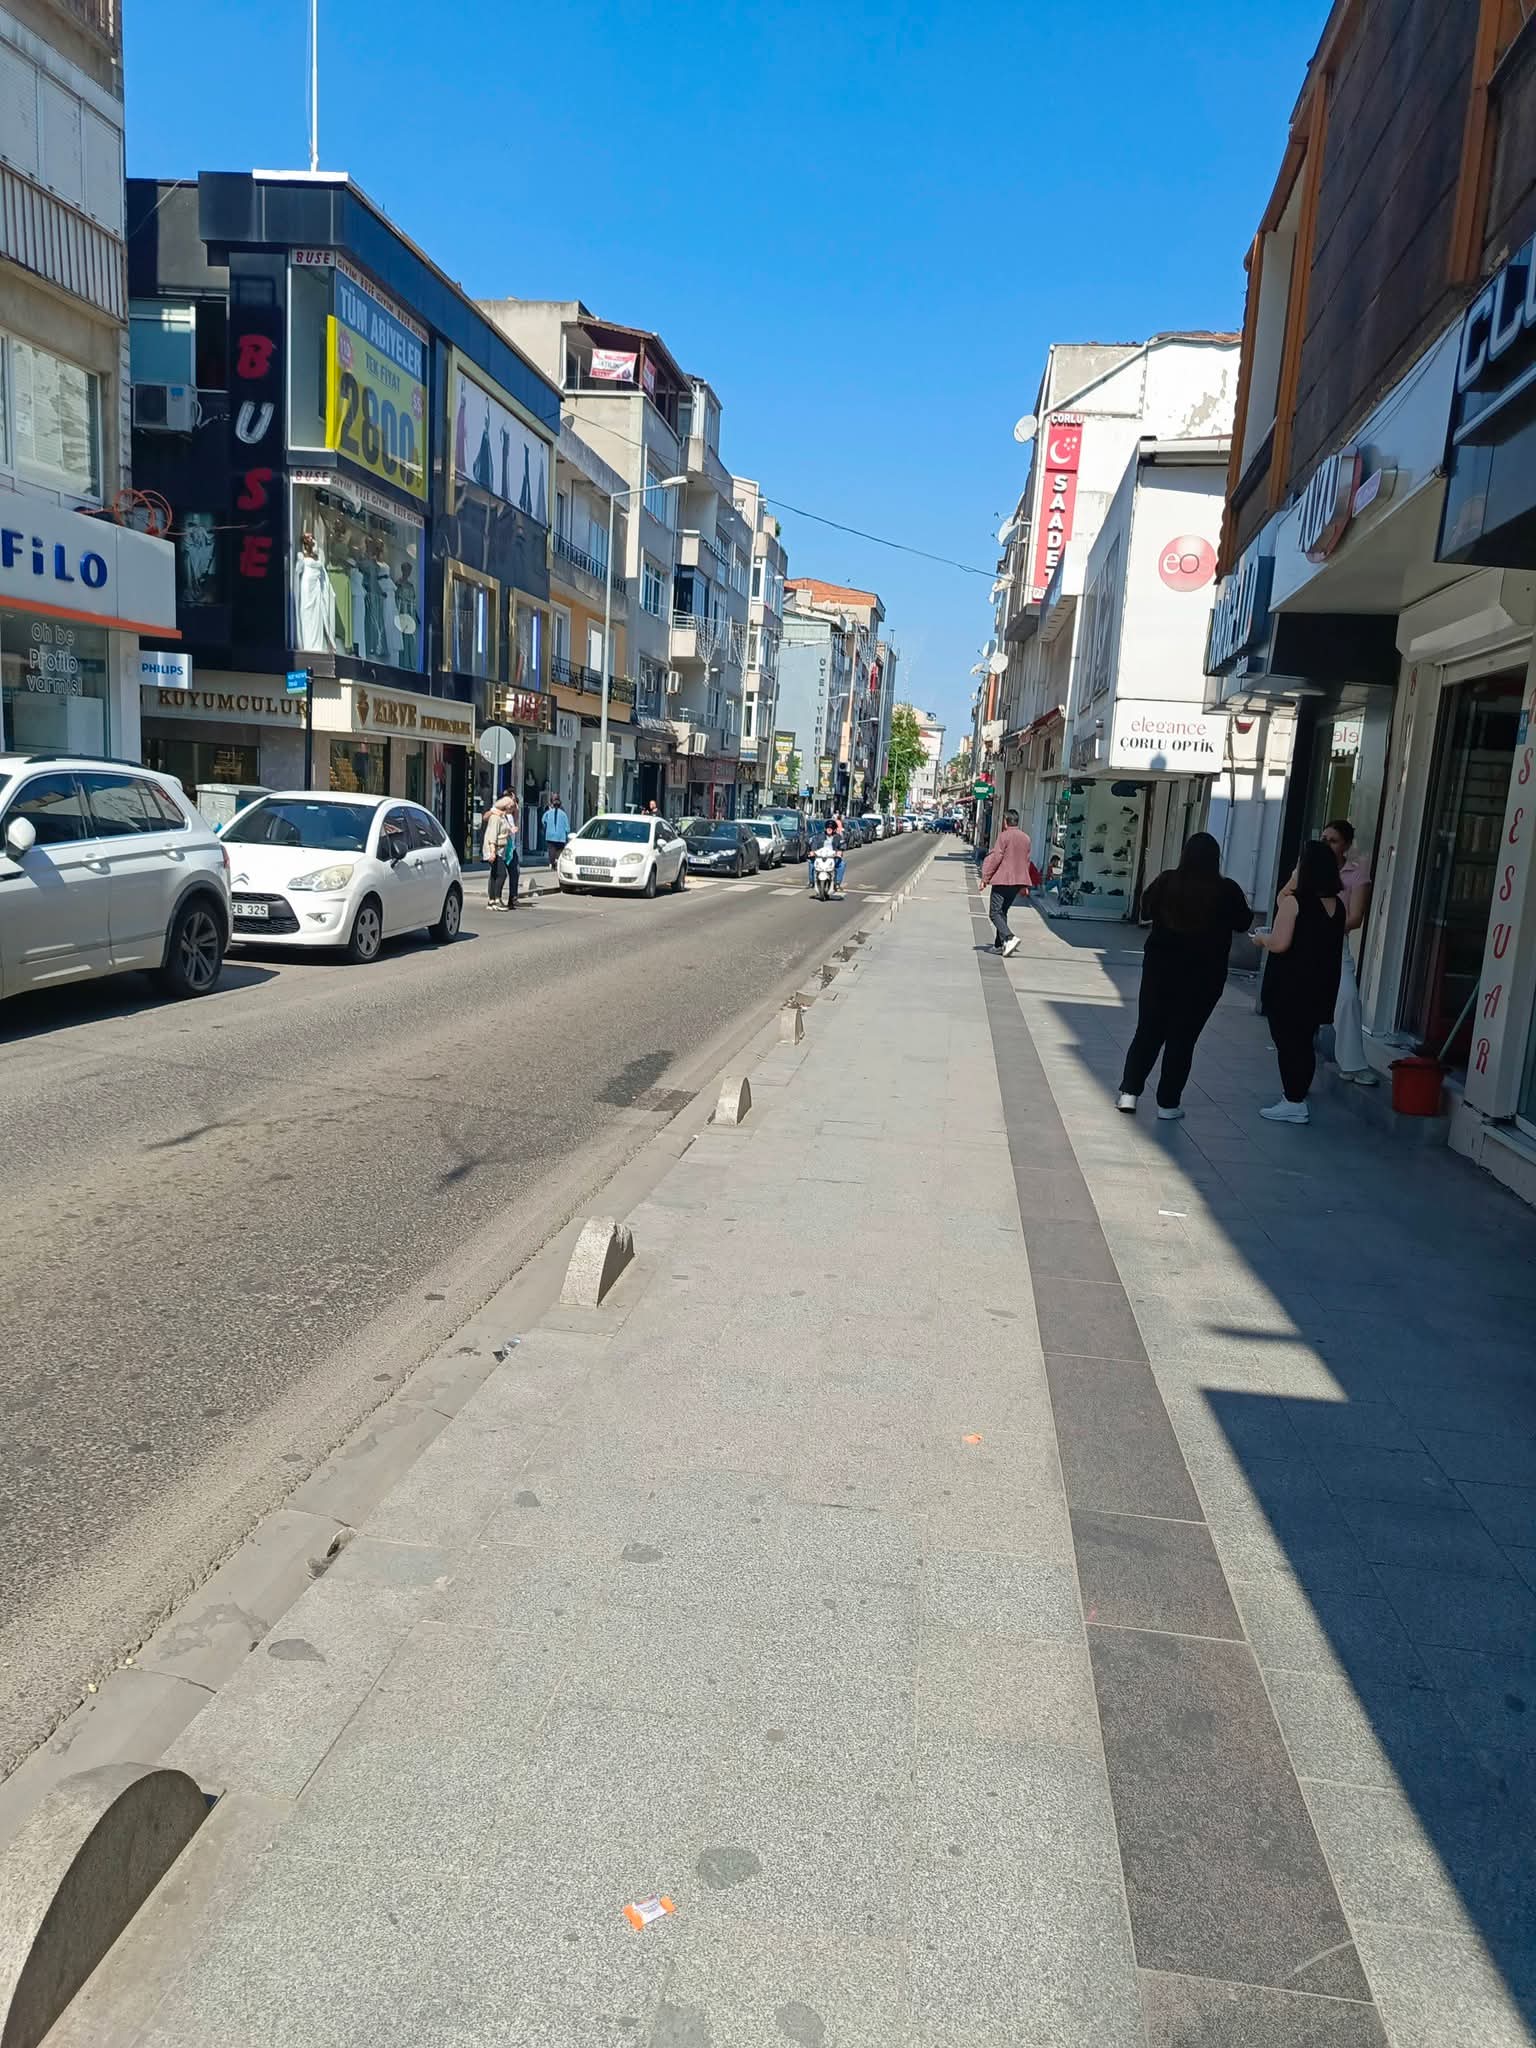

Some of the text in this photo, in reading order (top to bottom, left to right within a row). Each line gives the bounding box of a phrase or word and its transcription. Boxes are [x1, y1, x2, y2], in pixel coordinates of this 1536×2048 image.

[296, 252, 331, 263] BUSE
[341, 286, 368, 339] TÜM
[371, 312, 421, 379] ABİYELER
[235, 334, 274, 577] BUSE
[295, 470, 329, 481] BUSE
[55, 625, 75, 646] be
[29, 648, 78, 673] Profilo
[142, 663, 184, 676] PHILIPS
[159, 689, 307, 716] KUYUMCULUK
[1131, 715, 1207, 735] elegance
[1120, 737, 1214, 753] ÇORLU OPTİK
[247, 905, 266, 915] 325
